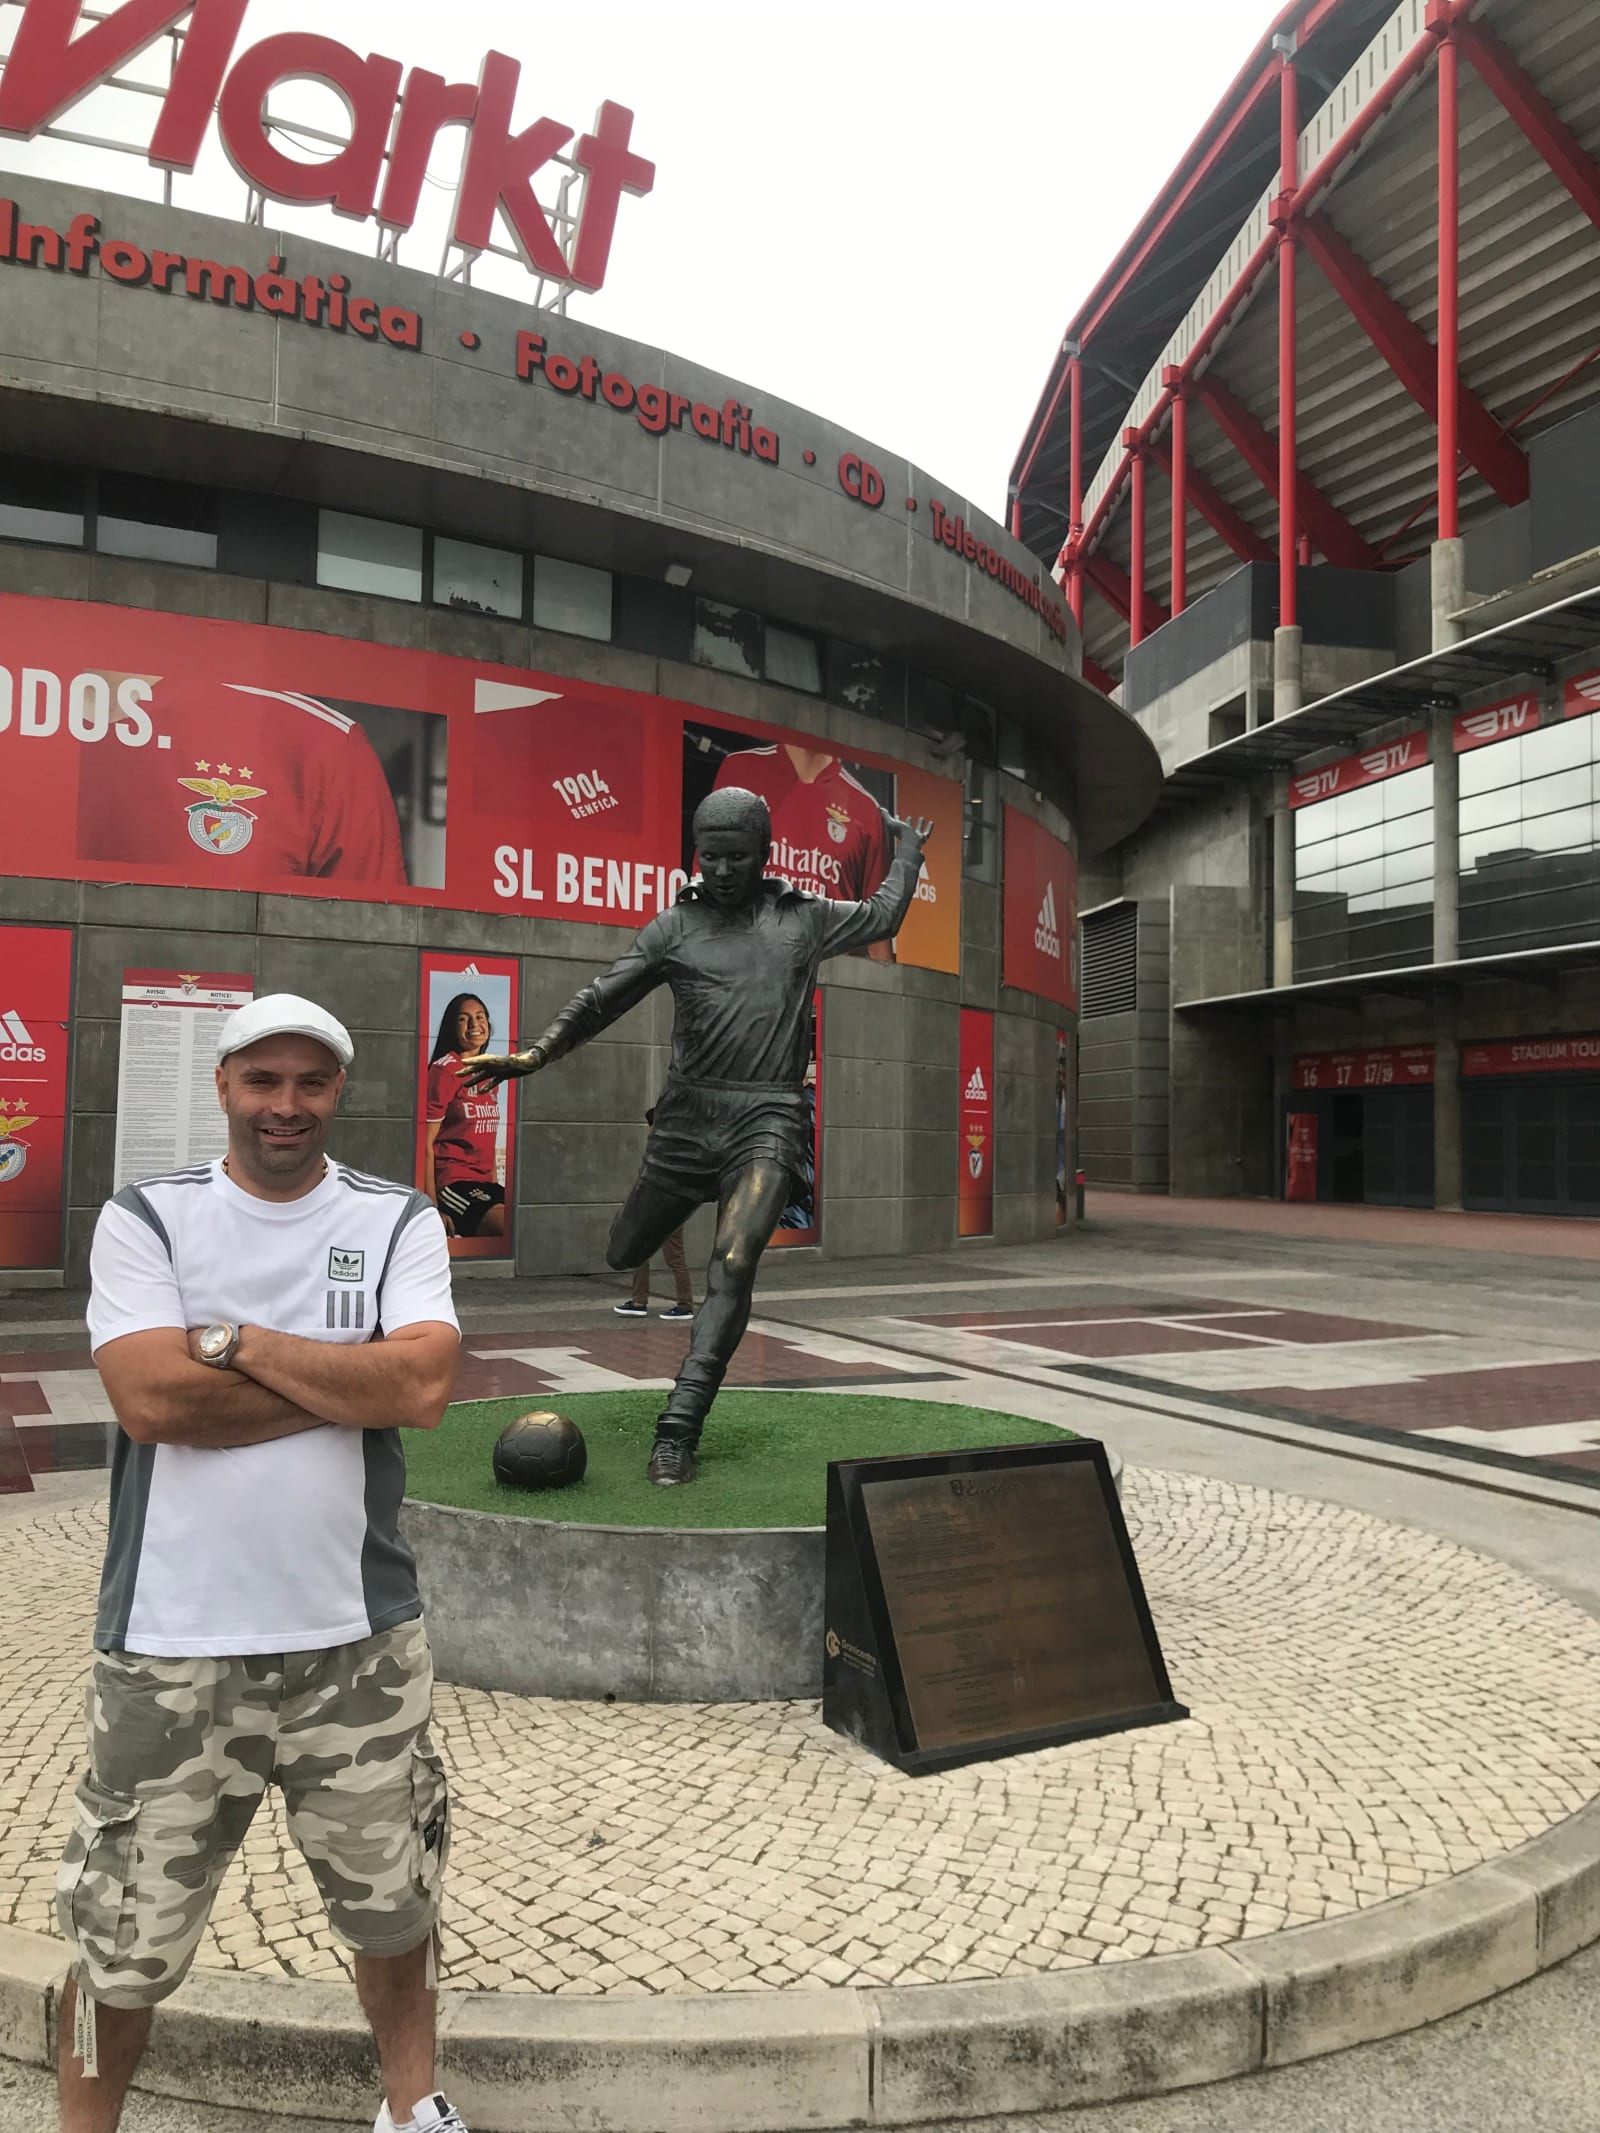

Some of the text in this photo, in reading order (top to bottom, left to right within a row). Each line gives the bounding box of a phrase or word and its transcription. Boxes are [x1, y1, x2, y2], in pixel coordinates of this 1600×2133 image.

[0, 198, 422, 350] Informática
[838, 453, 885, 508] CD
[552, 769, 610, 806] 1904
[570, 796, 619, 820] BENFICA
[493, 845, 704, 912] SL BENFIC
[1034, 927, 1061, 960] adidas
[1511, 1042, 1568, 1062] STADIUM
[1303, 1066, 1318, 1087] 16
[1336, 1065, 1352, 1085] 17
[1363, 1063, 1393, 1085] 17/19
[964, 1088, 988, 1100] adidas
[332, 1269, 359, 1278] adidas
